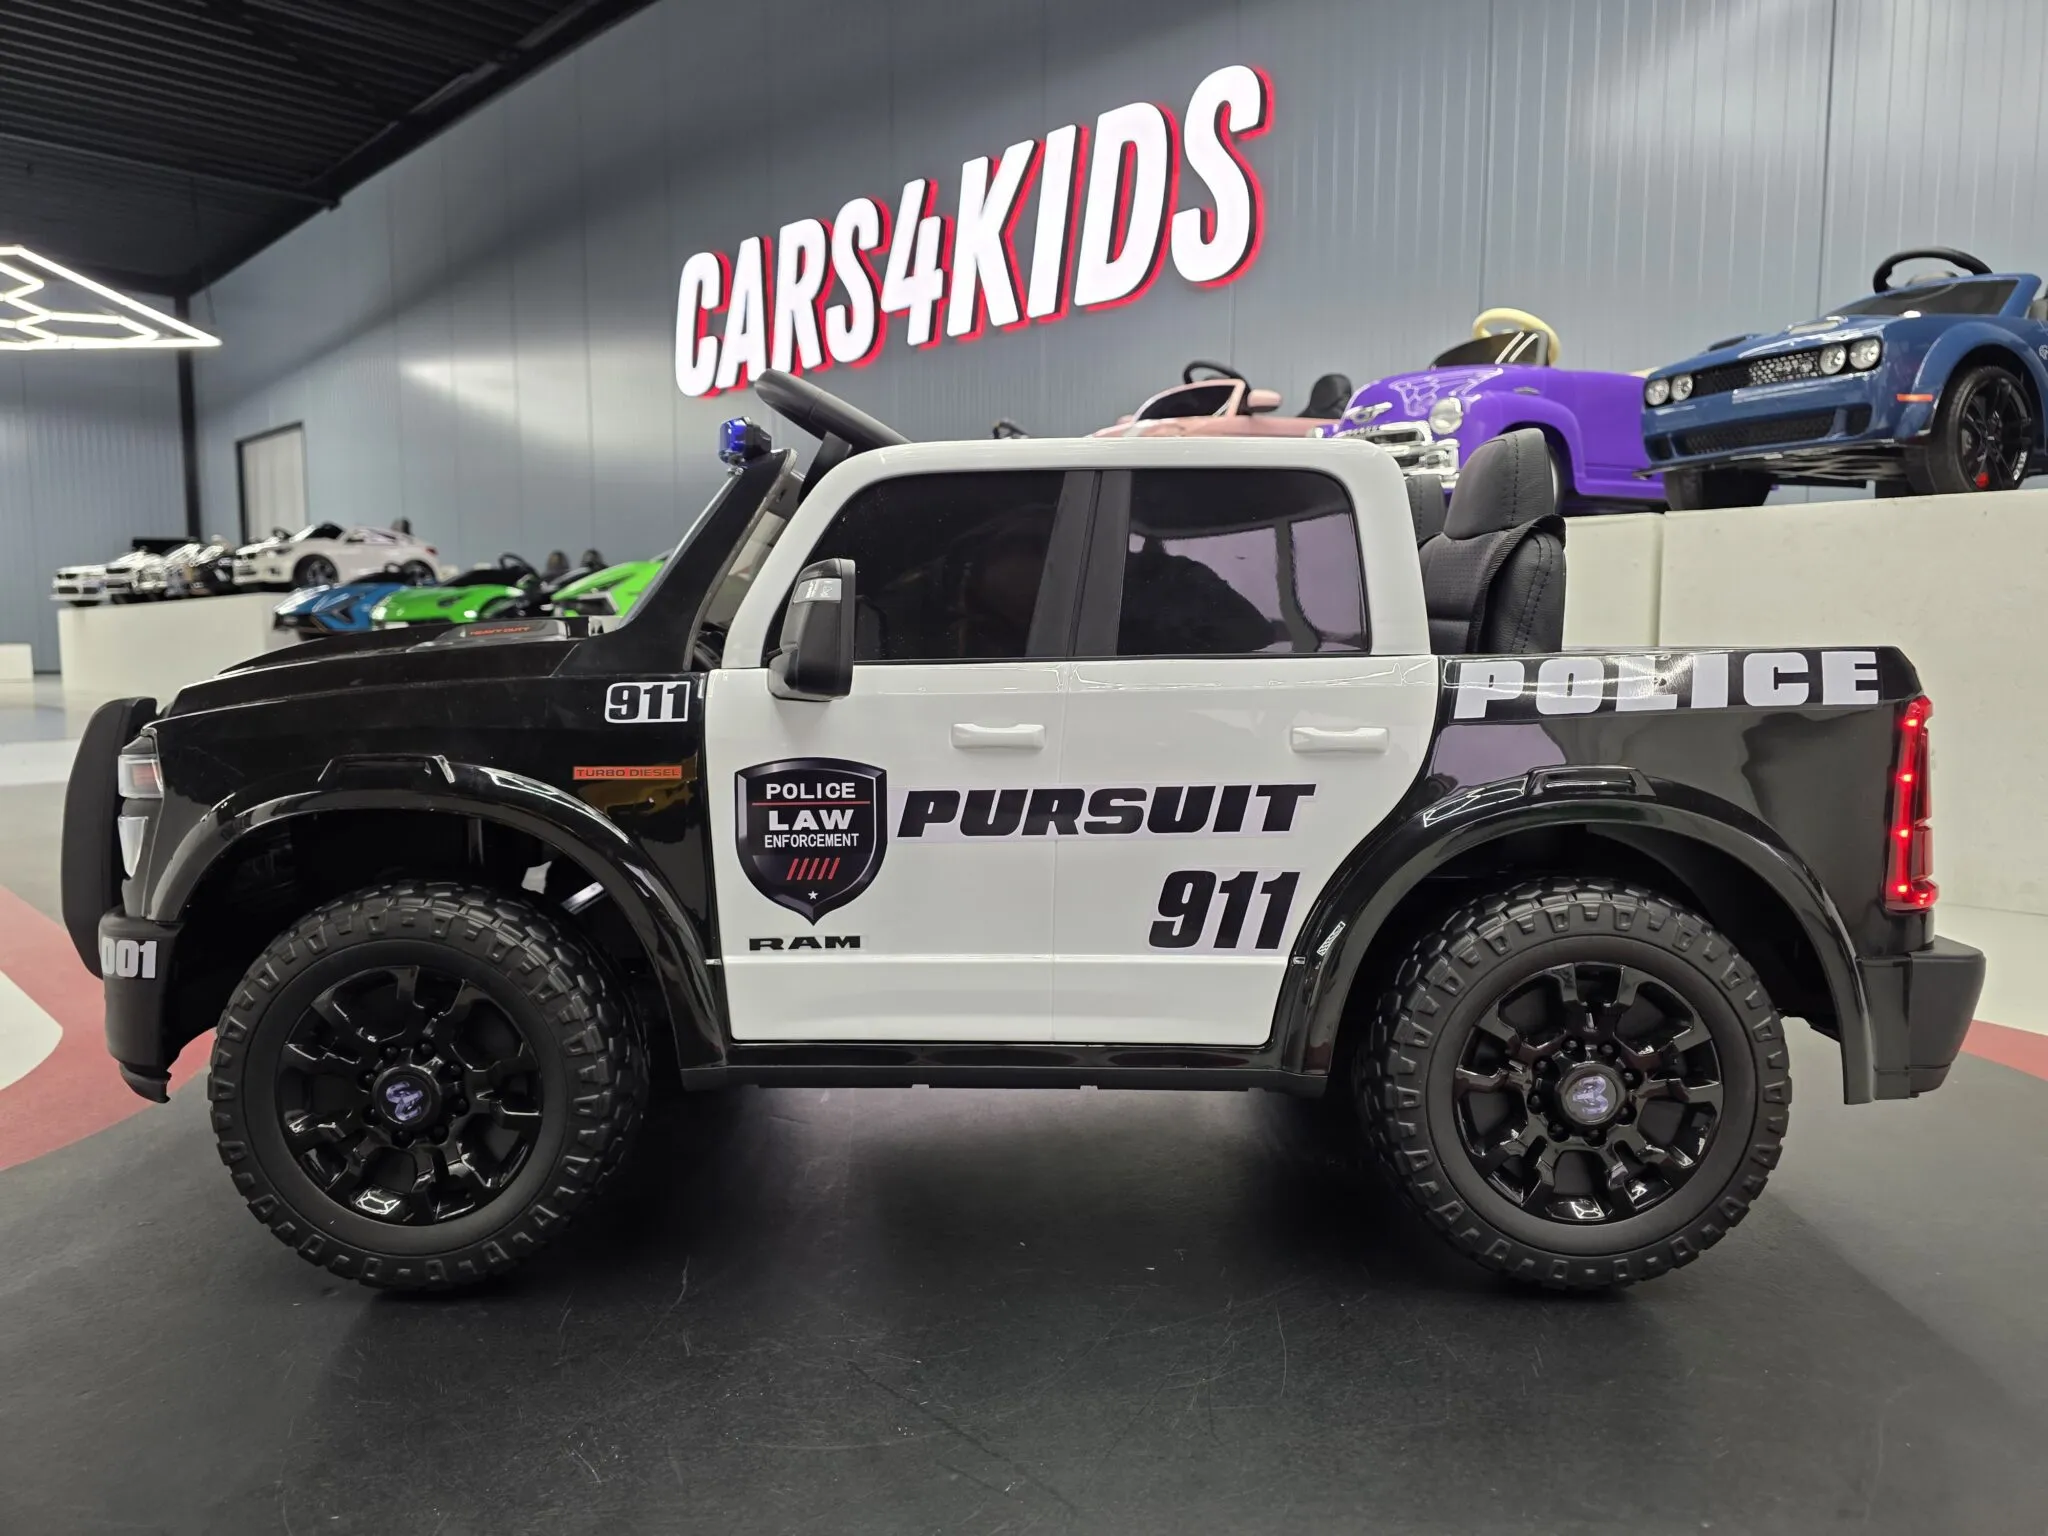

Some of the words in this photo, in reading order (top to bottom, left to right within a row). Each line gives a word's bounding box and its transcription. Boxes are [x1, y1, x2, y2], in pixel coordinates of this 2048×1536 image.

[675, 65, 1270, 397] CARS4KIDS
[608, 683, 688, 720] 911
[1453, 651, 1879, 719] POLICE
[576, 769, 625, 777] TURBO
[629, 768, 680, 777] DIESEL
[766, 782, 856, 800] POLICE
[768, 809, 854, 831] LAW
[897, 784, 1316, 838] PURSUIT
[764, 833, 860, 848] ENFORCEMENT
[1149, 870, 1300, 949] 911
[101, 937, 157, 979] 001
[749, 935, 861, 951] RAM
